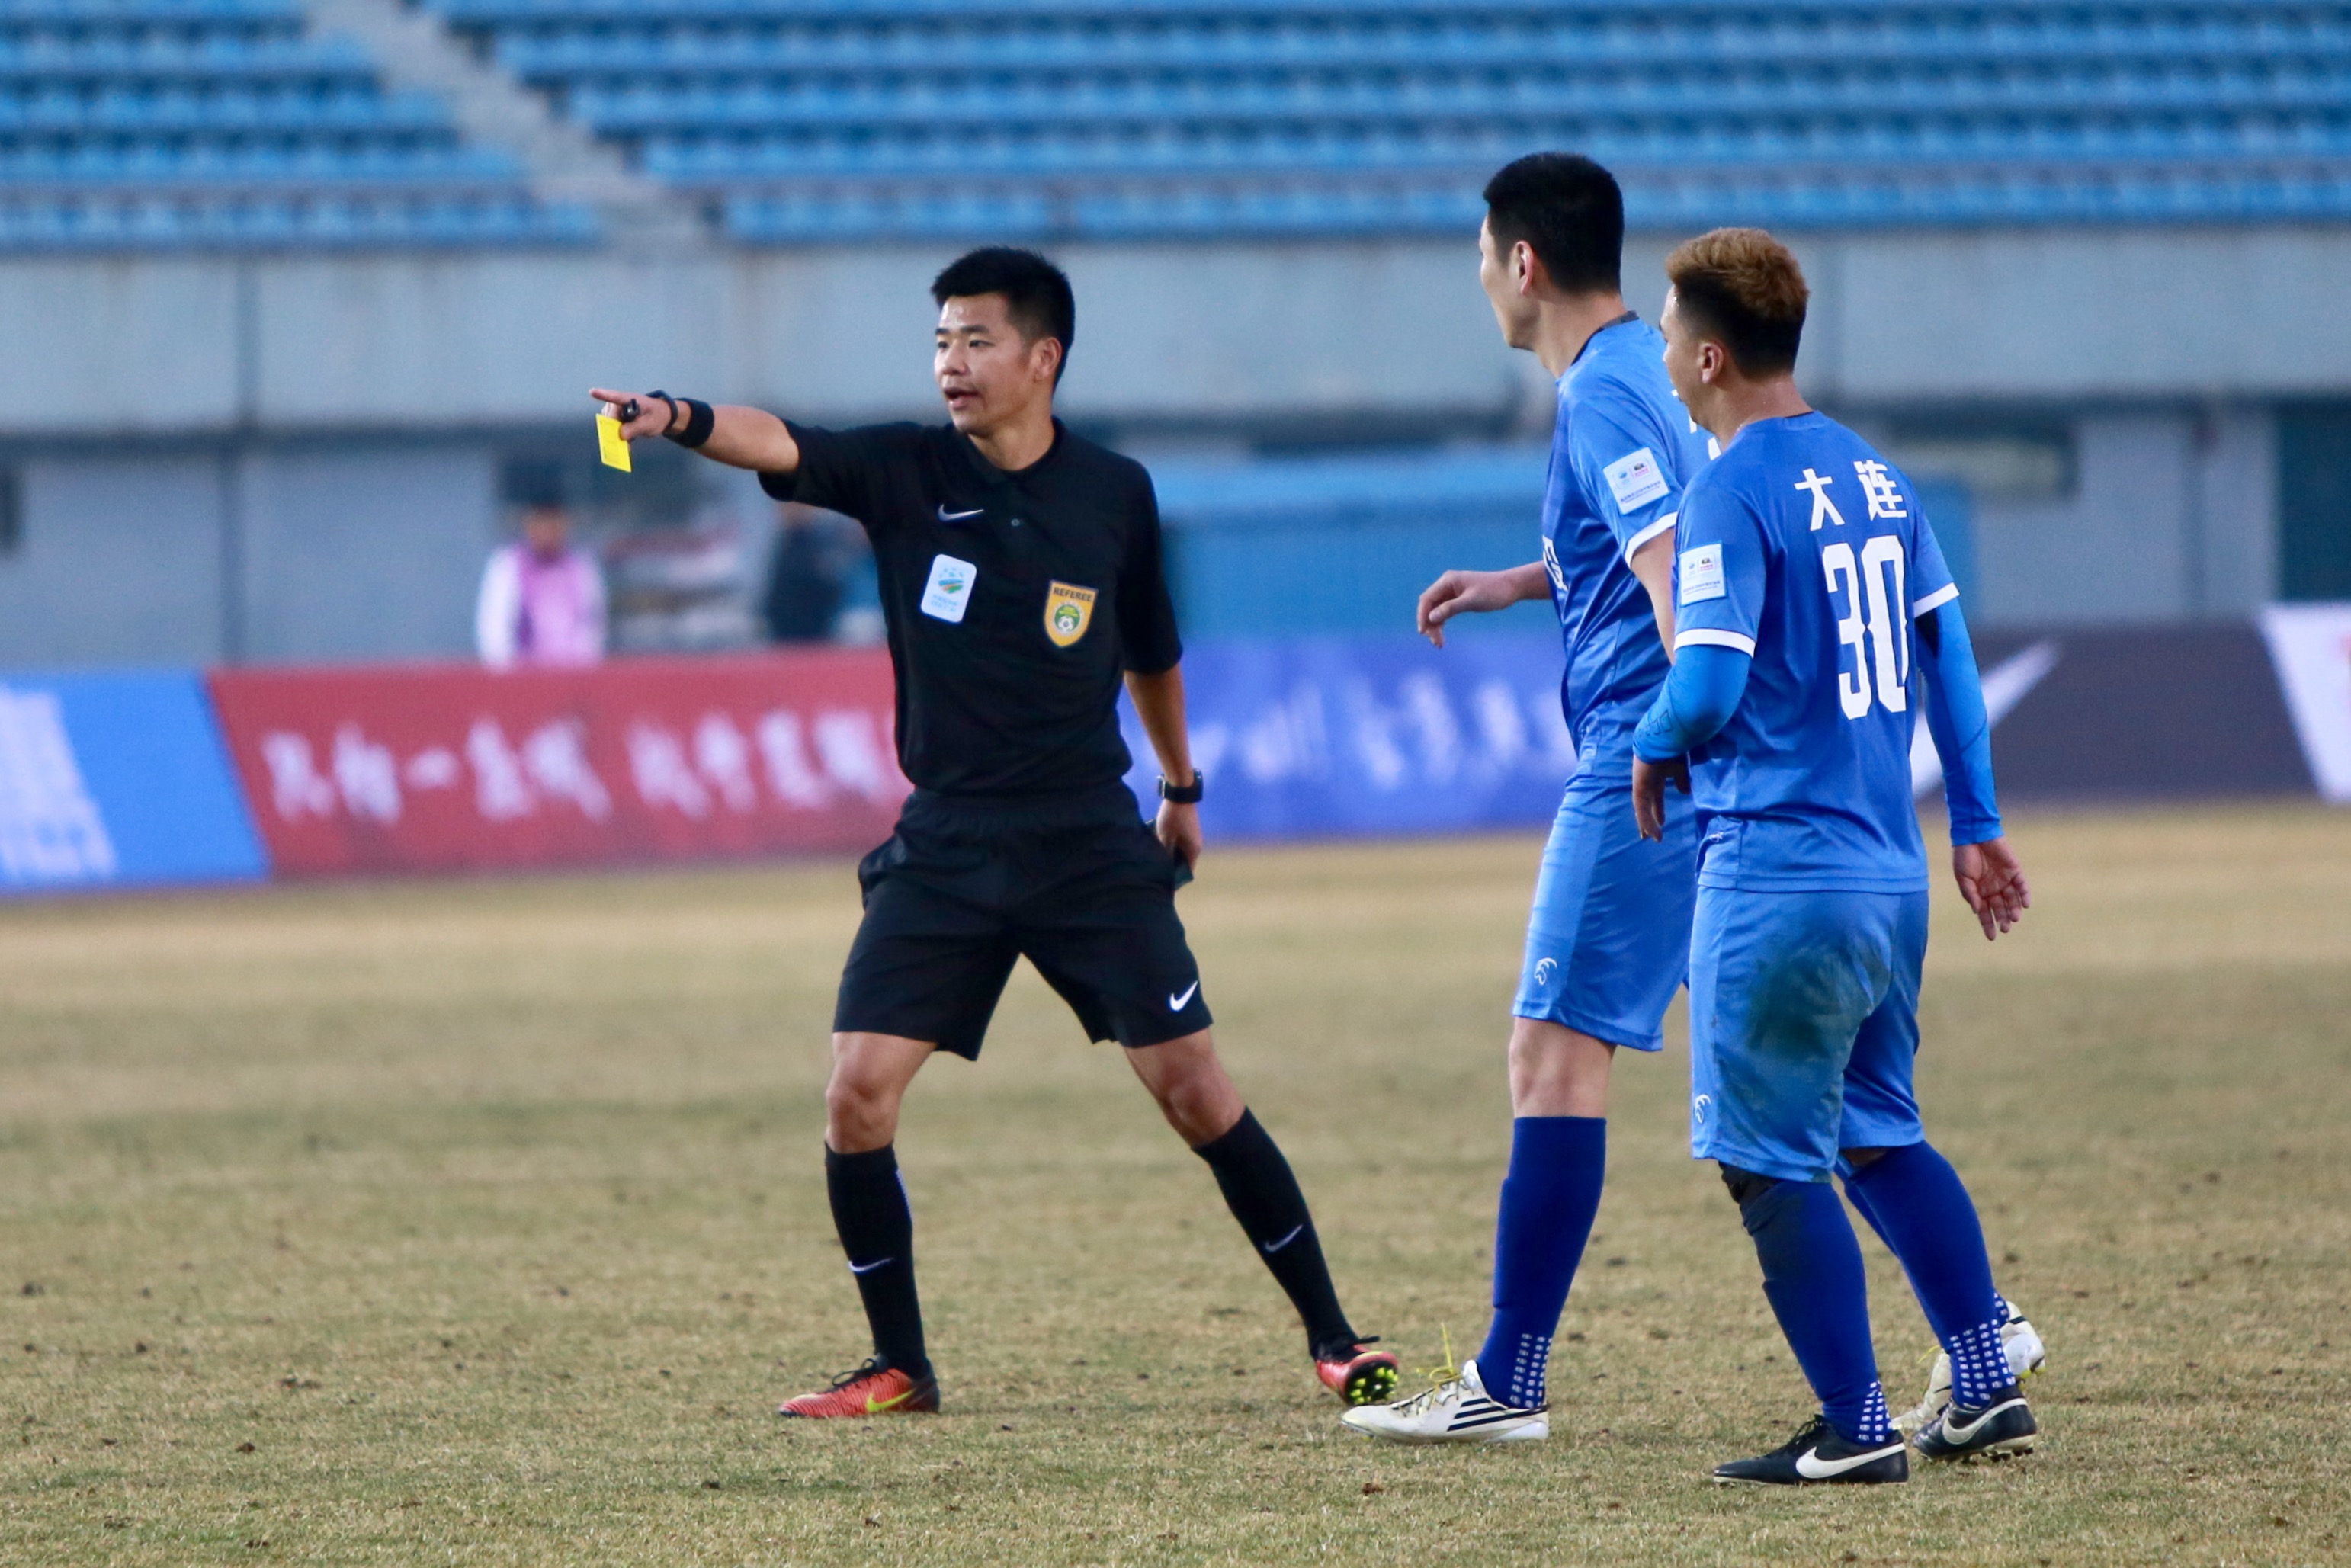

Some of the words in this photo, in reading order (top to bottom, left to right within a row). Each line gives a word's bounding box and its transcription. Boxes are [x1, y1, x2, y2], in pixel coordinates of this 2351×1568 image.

[1795, 460, 1907, 531] 大连
[1054, 587, 1092, 601] REFEREE
[1822, 535, 1909, 720] 30
